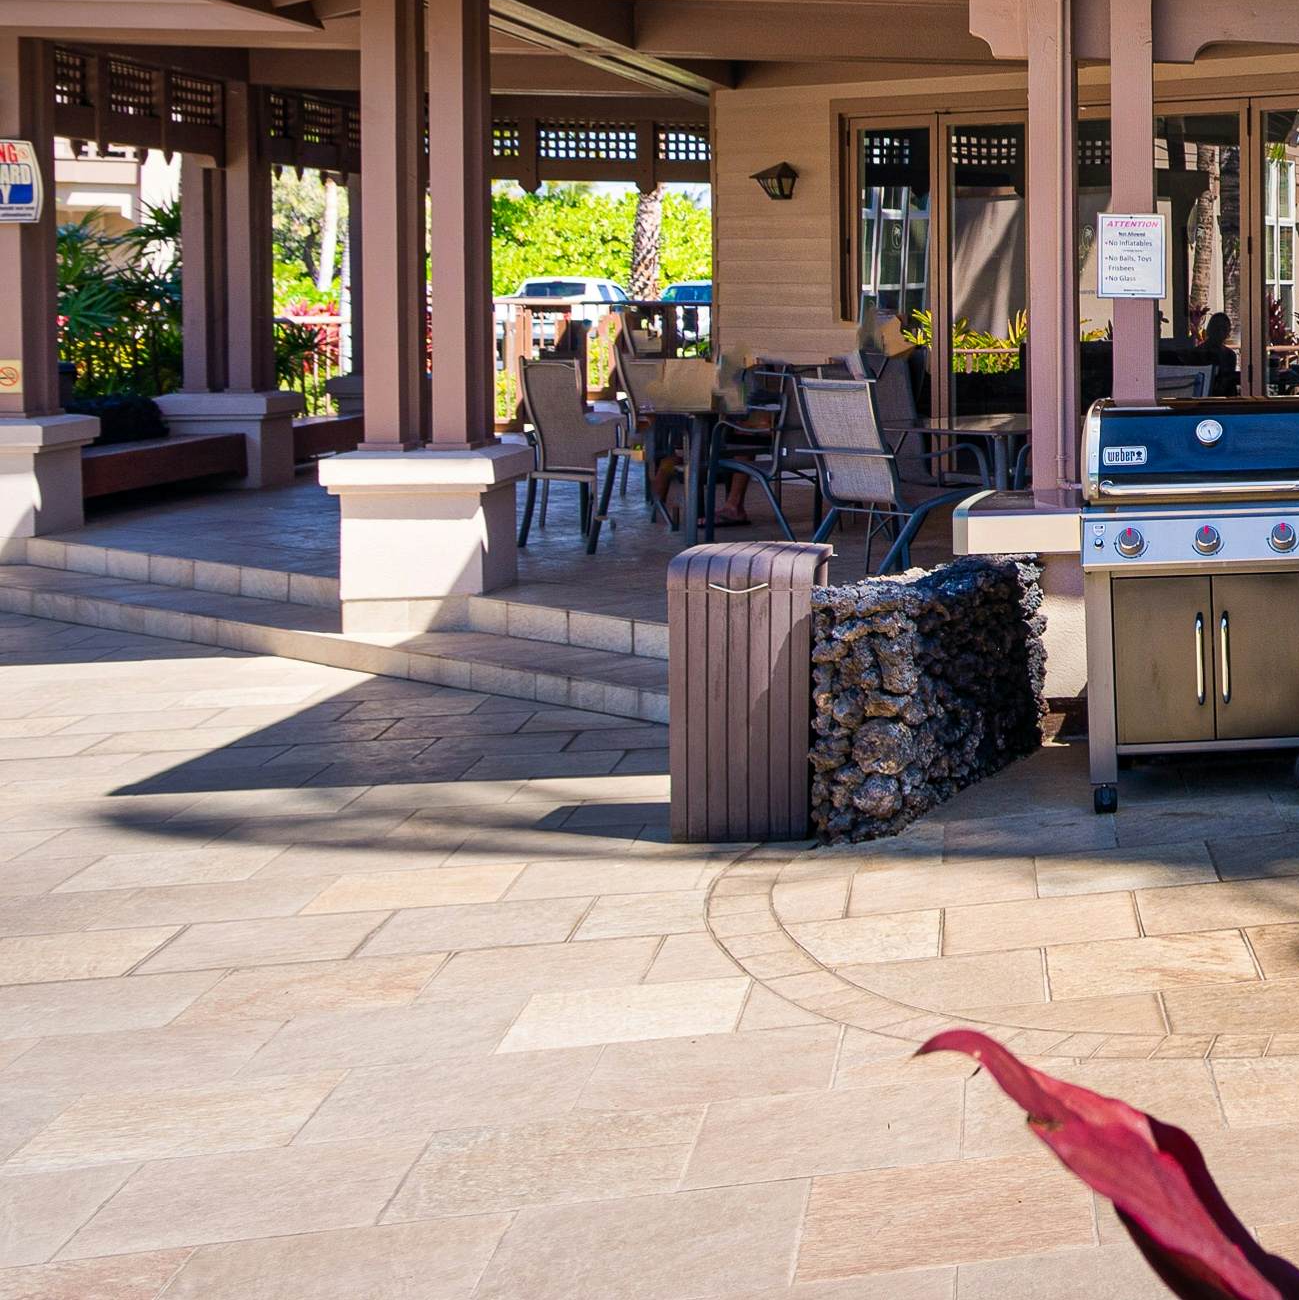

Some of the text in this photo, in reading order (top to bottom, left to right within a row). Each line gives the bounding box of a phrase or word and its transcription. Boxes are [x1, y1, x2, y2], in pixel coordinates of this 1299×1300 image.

[1107, 220, 1159, 228] ATTENTION
[1119, 239, 1153, 247] Inflatables
[1107, 448, 1136, 462] weber
